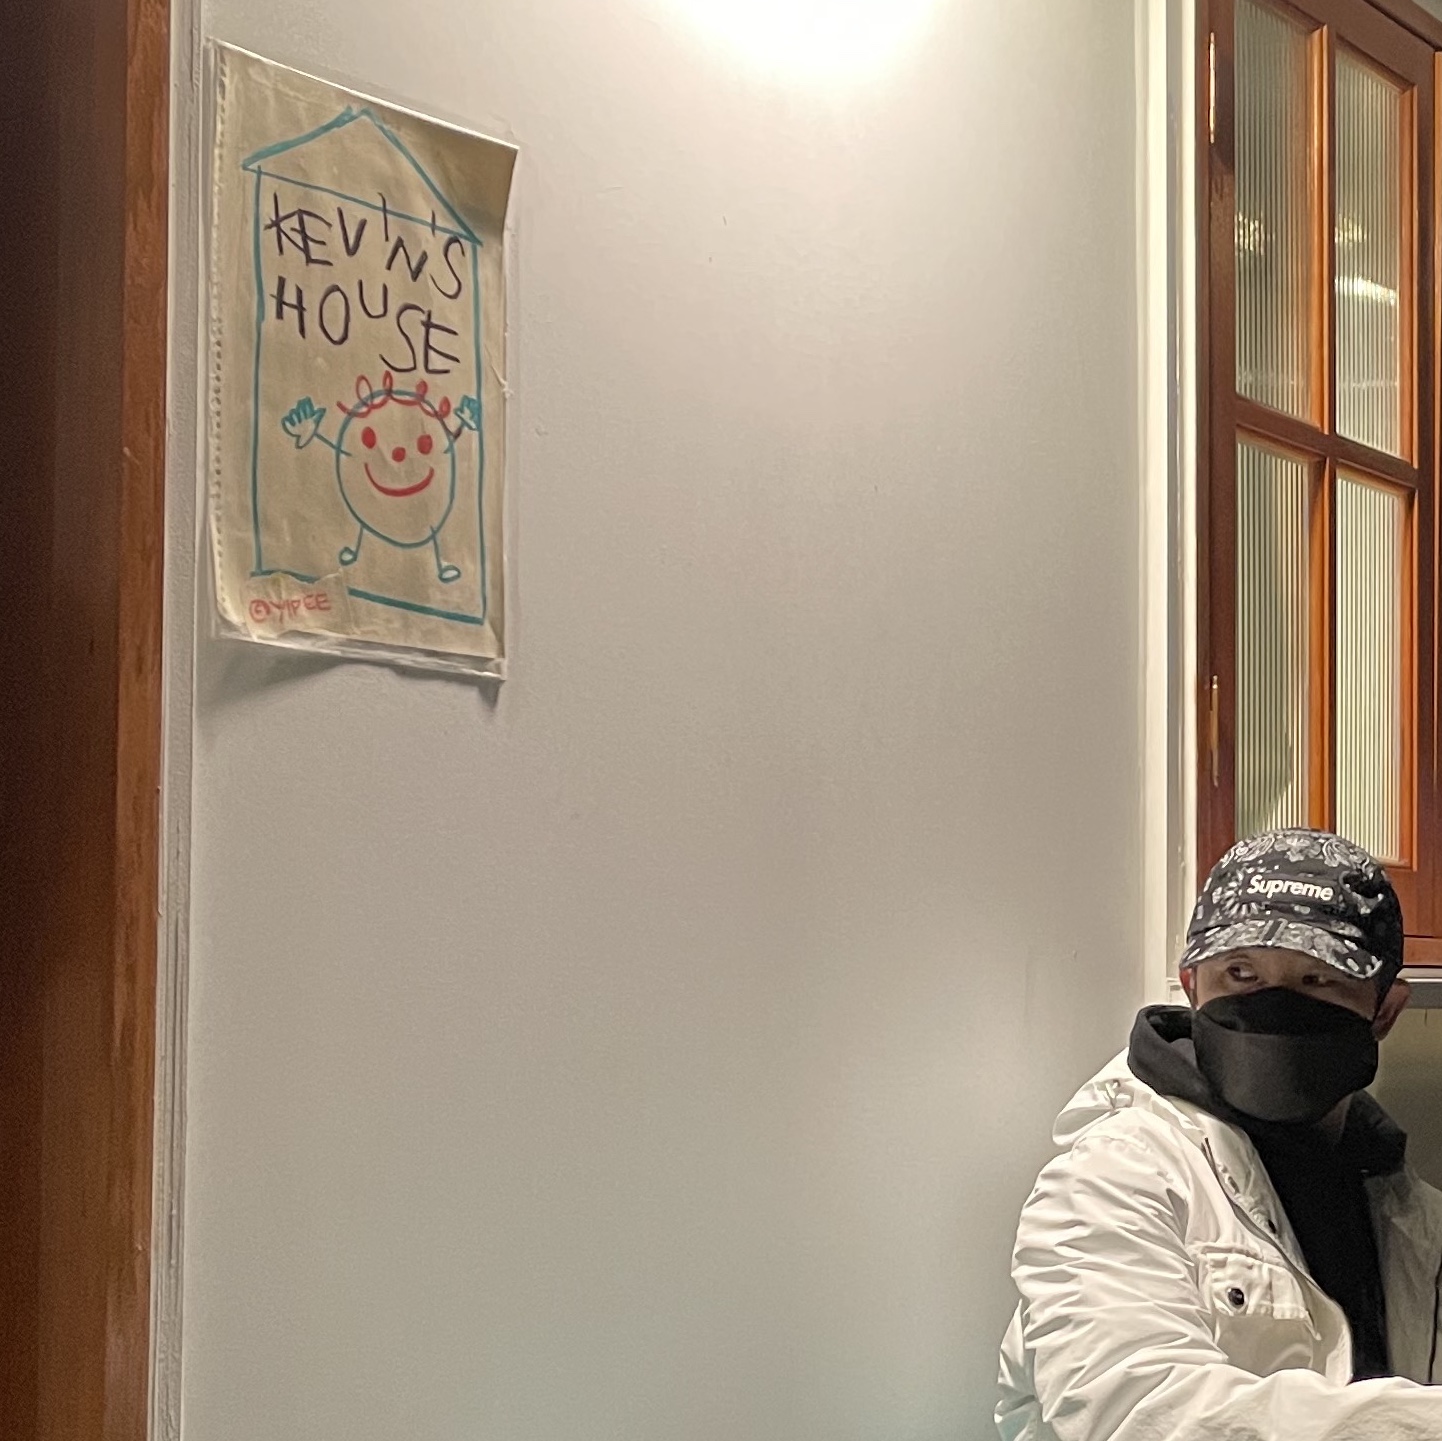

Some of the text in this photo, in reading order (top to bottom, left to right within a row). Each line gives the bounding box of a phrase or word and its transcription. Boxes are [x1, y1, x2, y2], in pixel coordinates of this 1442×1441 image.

[263, 191, 466, 300] KEVIN'S
[269, 275, 461, 374] HOUSE
[1246, 874, 1334, 901] Supreme
